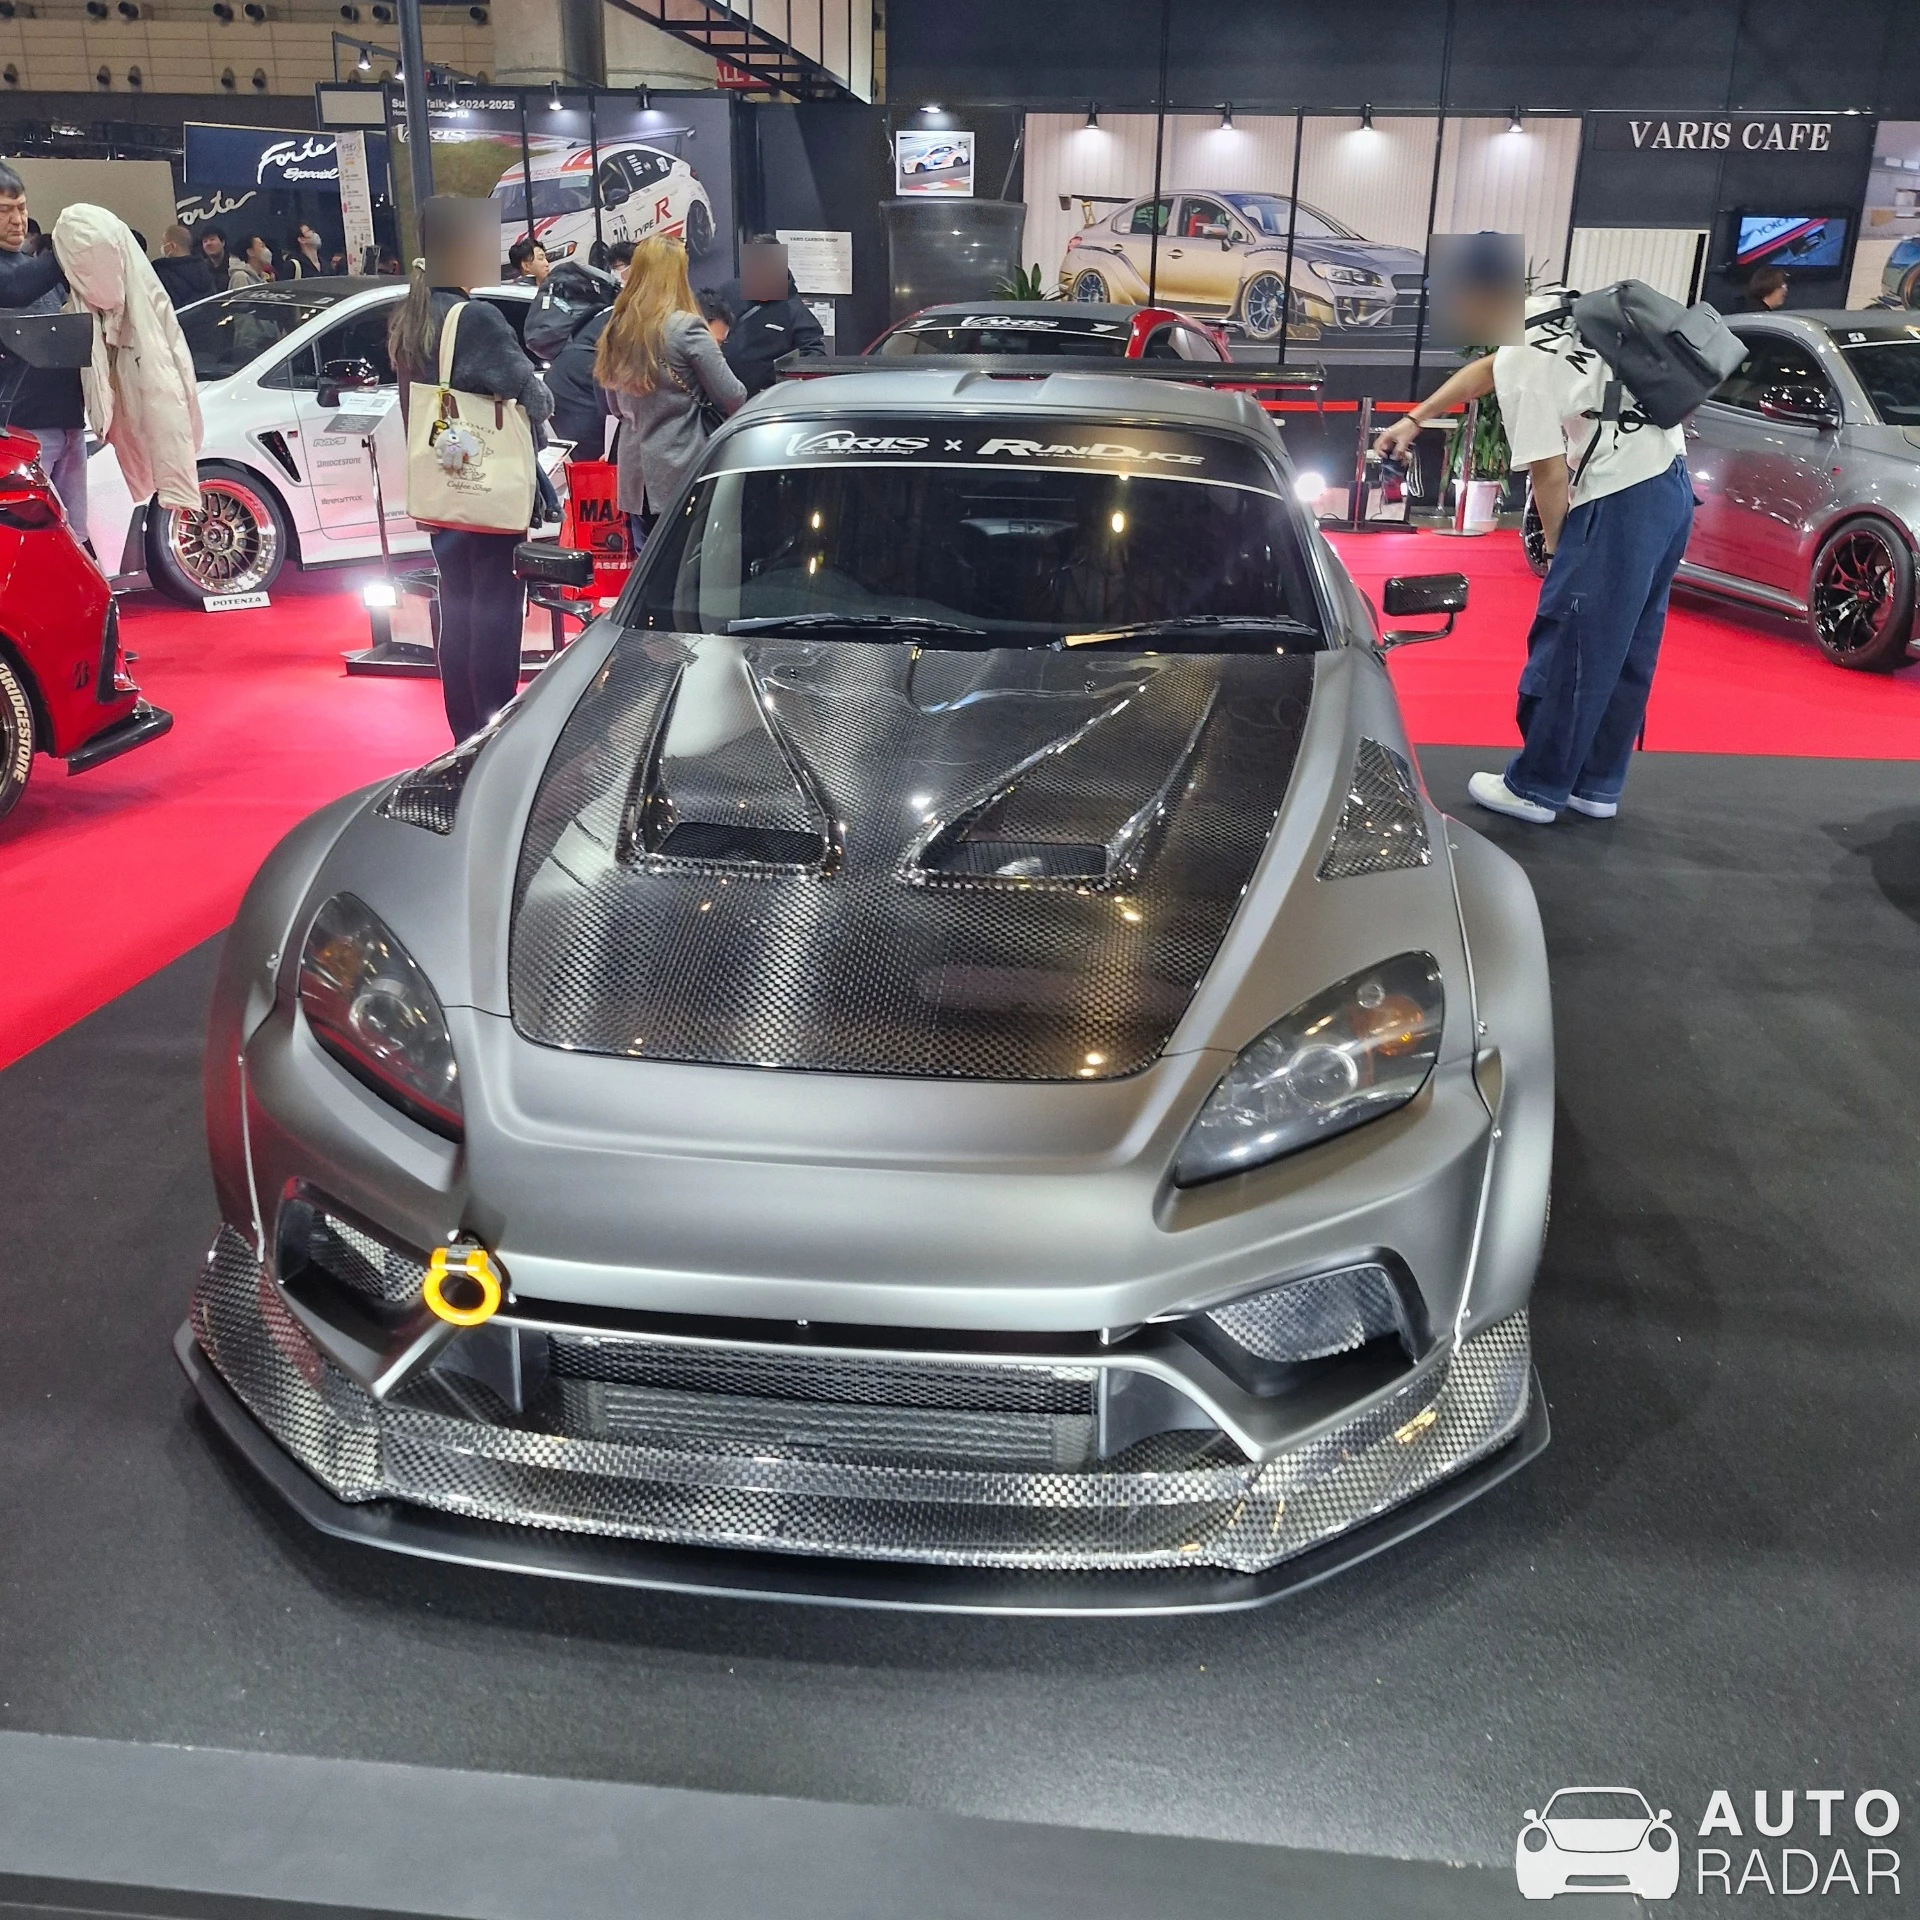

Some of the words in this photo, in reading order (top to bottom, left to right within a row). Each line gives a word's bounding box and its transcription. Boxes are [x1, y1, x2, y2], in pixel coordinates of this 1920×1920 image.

[459, 100, 516, 110] 2024-2025
[396, 123, 466, 142] VRIS
[1629, 121, 1731, 149] VARIS
[1742, 122, 1832, 151] CAFE
[655, 197, 672, 224] R
[634, 219, 655, 238] TYPE
[786, 430, 930, 456] VARIS
[317, 457, 361, 468] BRIDGESTONE
[447, 480, 470, 490] Coffee
[472, 483, 492, 494] Shop
[213, 597, 262, 607] POTENZA
[0, 662, 33, 785] BRIDGESTONE
